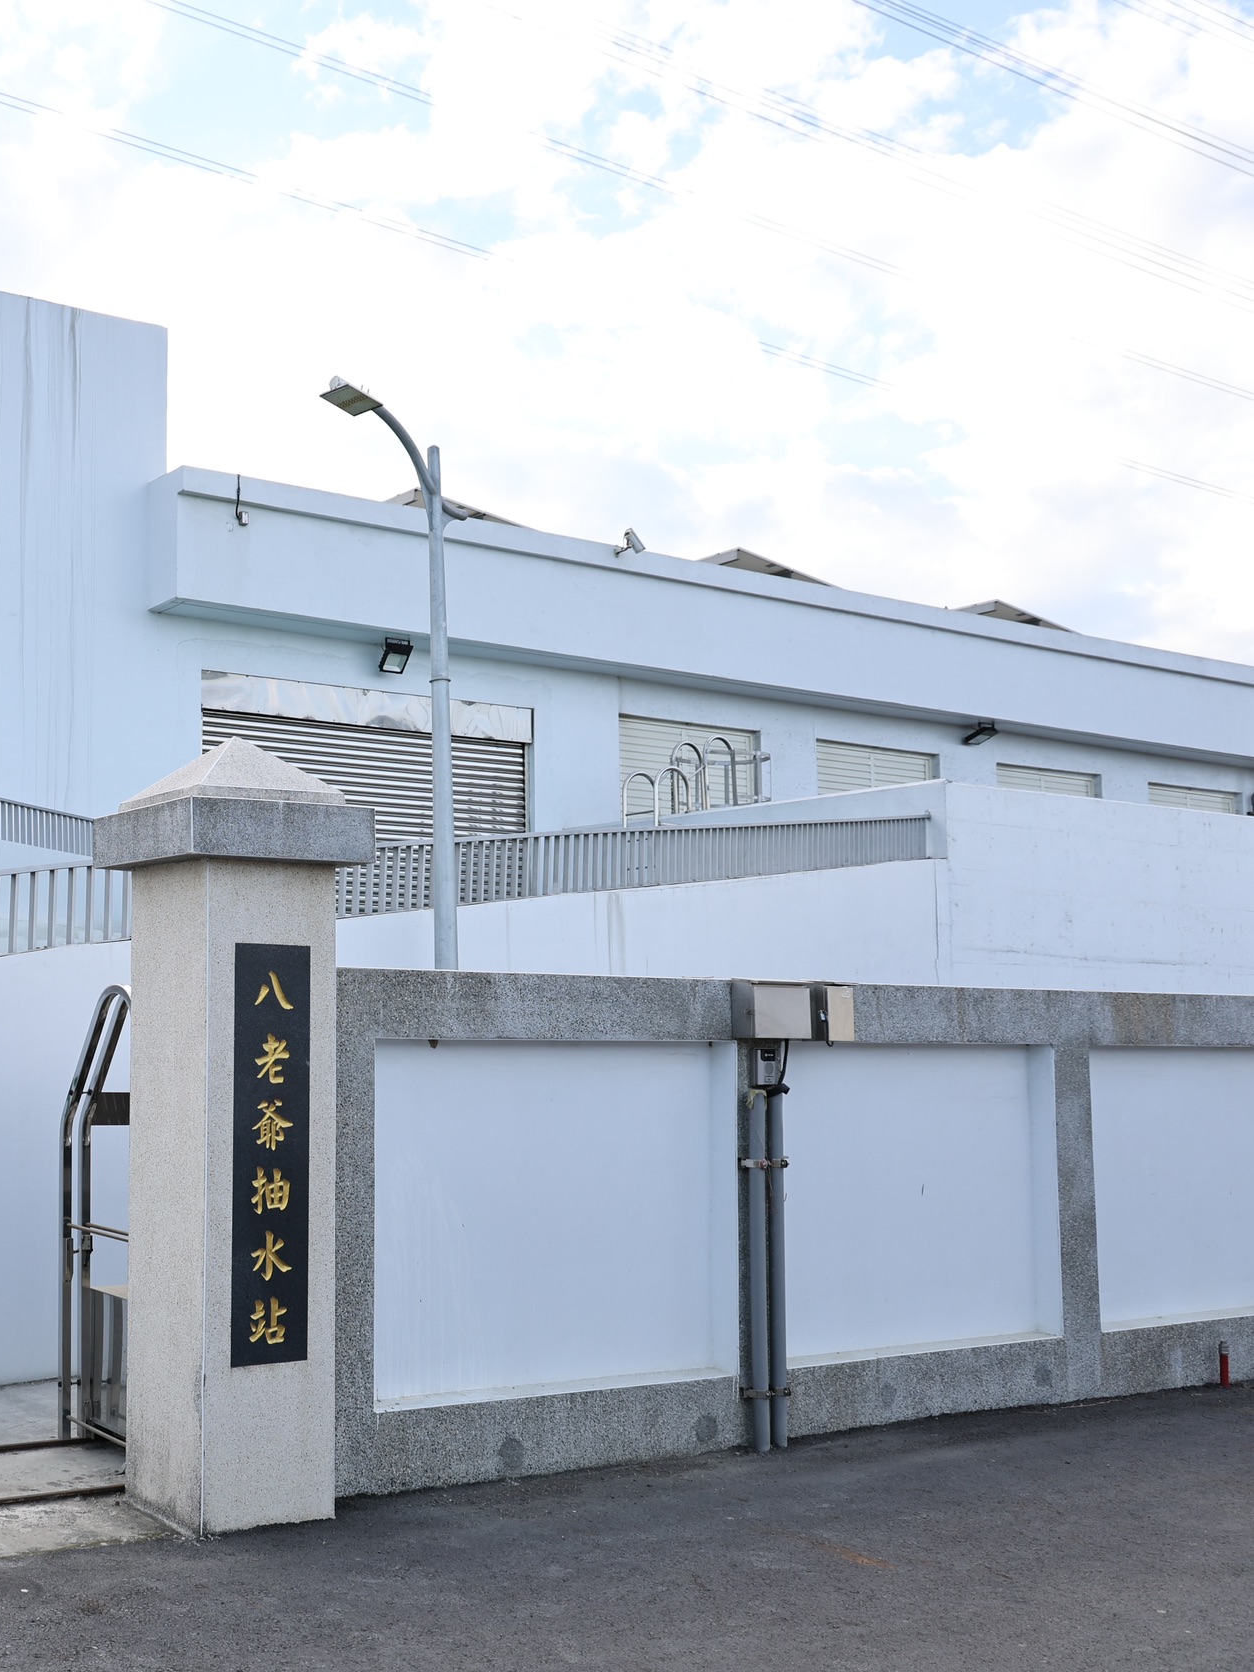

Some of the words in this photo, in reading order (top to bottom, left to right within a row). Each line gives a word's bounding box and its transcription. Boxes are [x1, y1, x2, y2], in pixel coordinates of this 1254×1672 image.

[249, 969, 294, 1345] 八老爺抽水站
